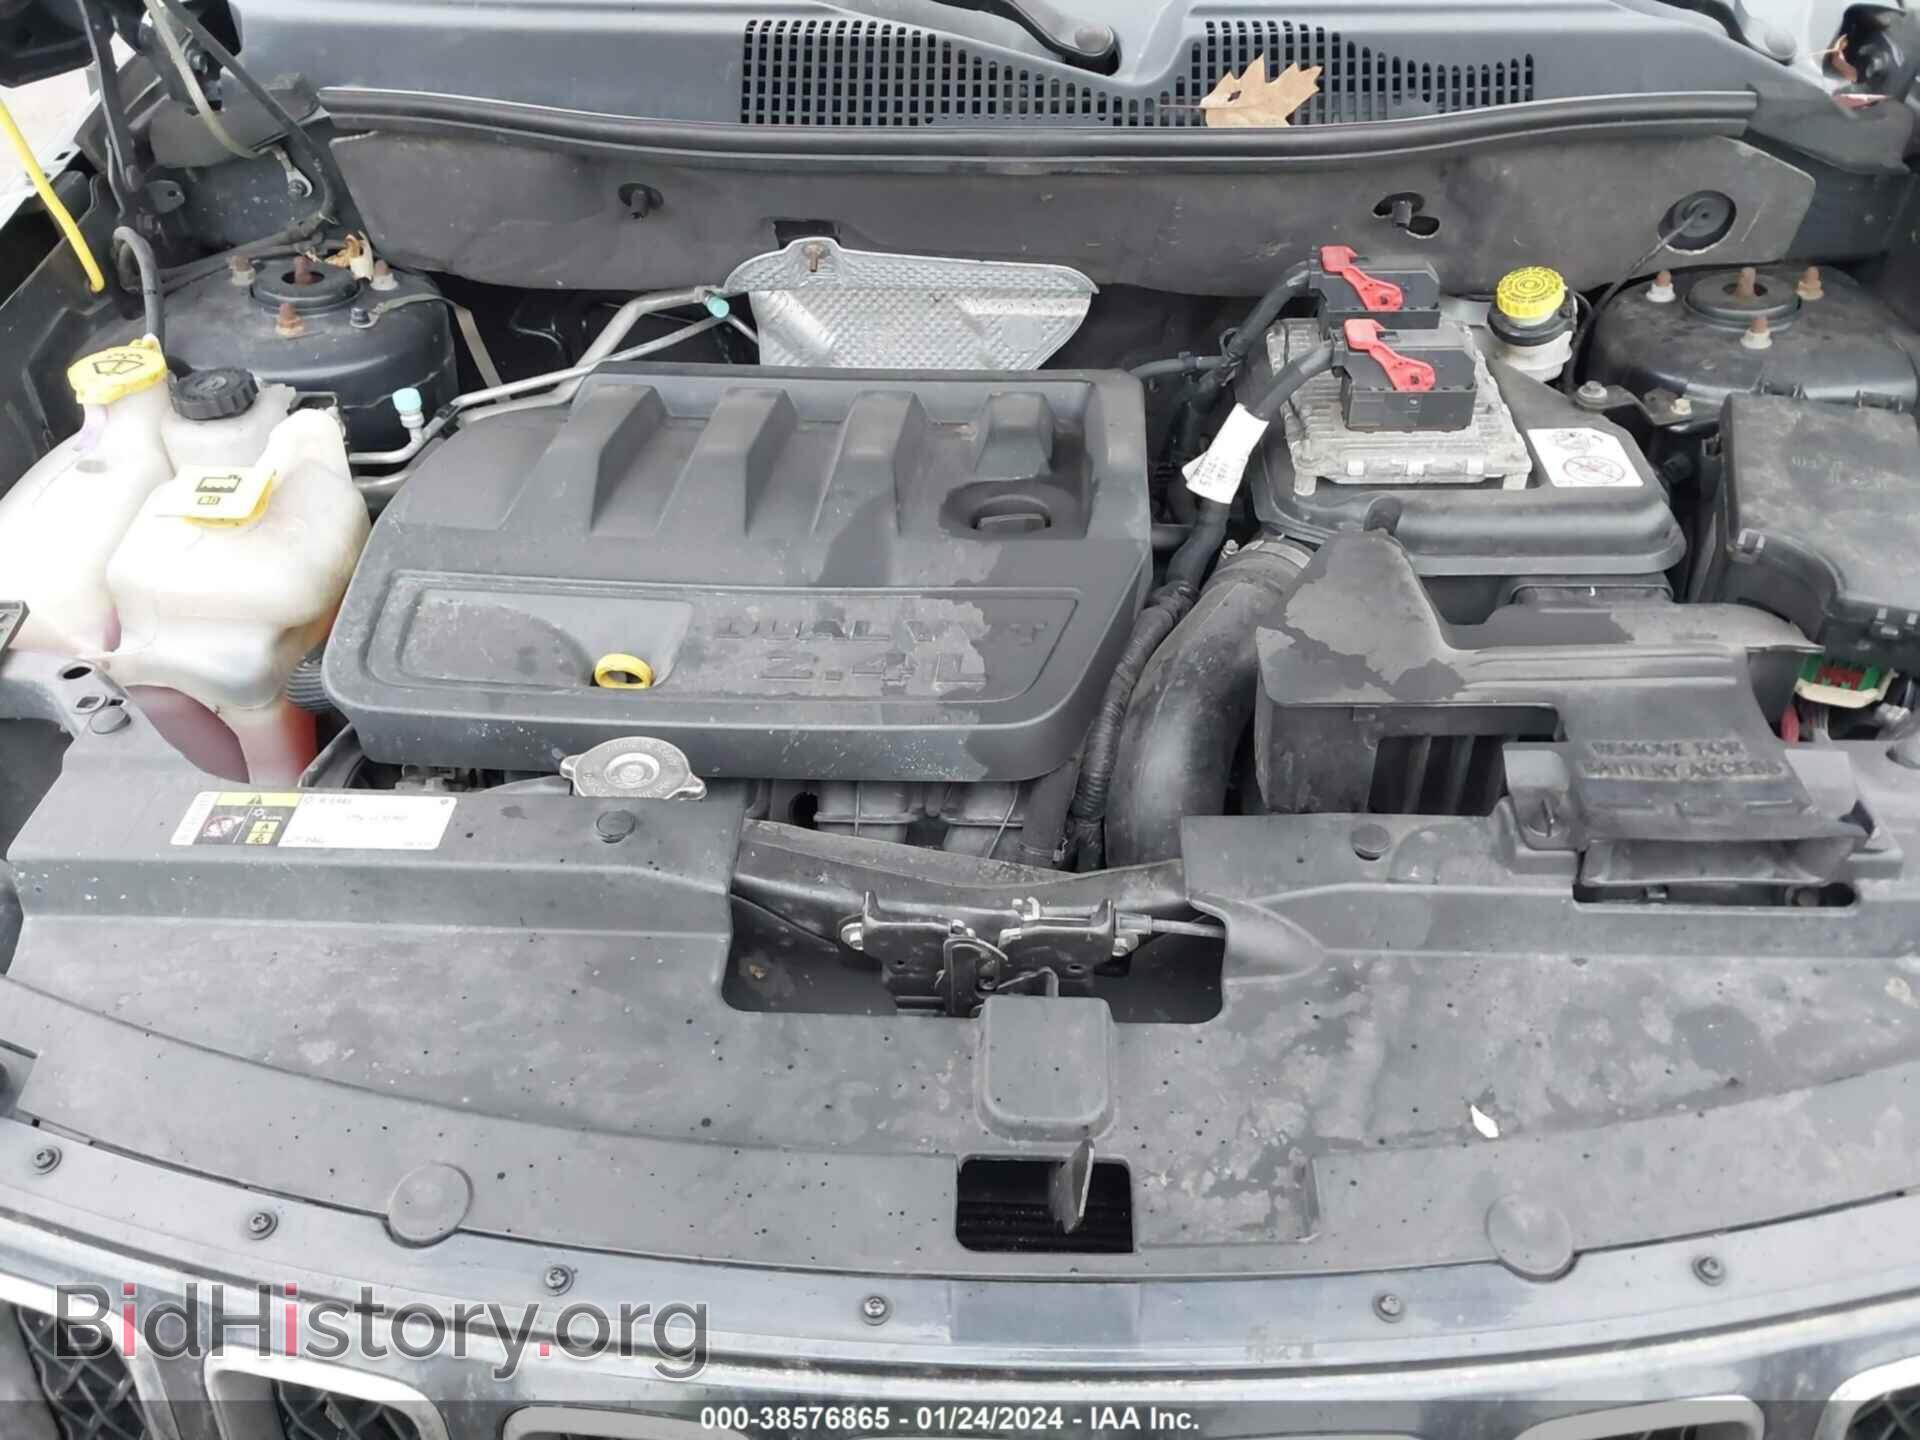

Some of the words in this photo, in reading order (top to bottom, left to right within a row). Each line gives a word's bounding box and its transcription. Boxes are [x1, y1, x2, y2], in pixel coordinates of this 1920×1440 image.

[1591, 740, 1682, 757] REMOVE
[1694, 740, 1746, 757] FOR
[1689, 760, 1786, 779] ACCESS
